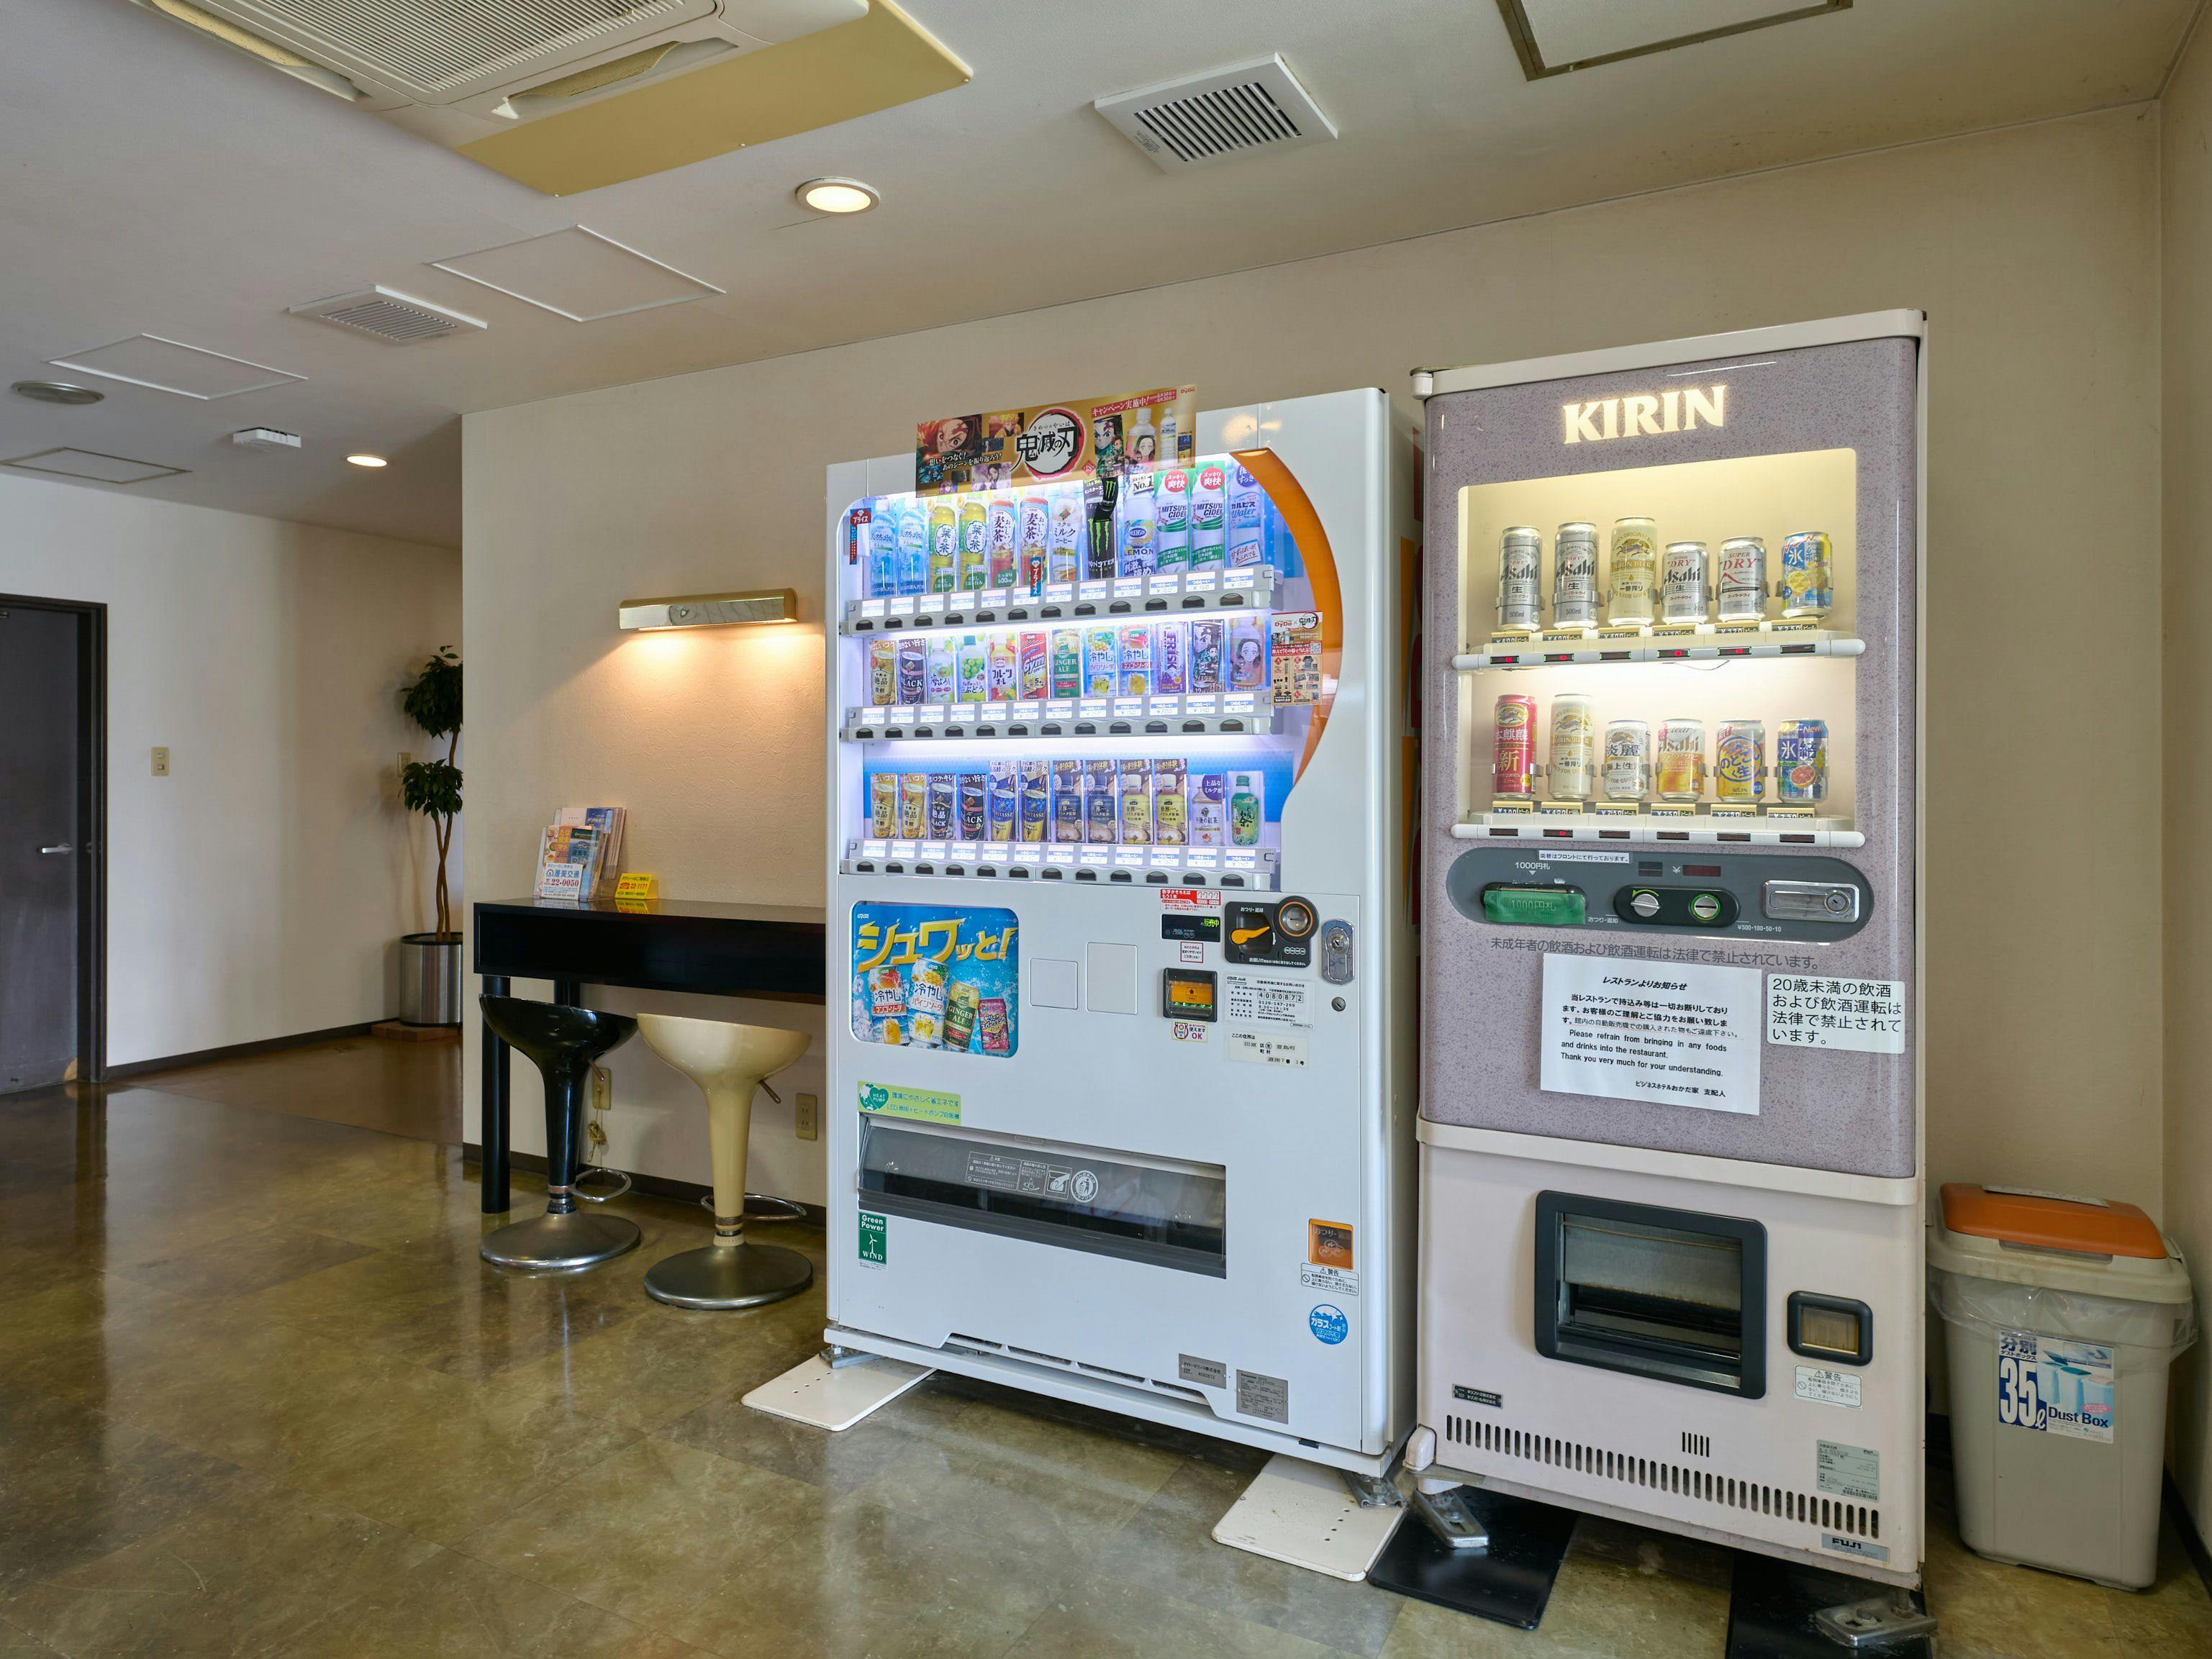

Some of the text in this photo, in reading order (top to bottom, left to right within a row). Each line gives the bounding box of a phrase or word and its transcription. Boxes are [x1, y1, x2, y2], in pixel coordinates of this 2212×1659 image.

[1563, 386, 1727, 445] KIRIN
[1010, 426, 1080, 472] 鬼滅の刃
[1167, 481, 1186, 489] 爽快
[1203, 478, 1222, 486] 爽快
[853, 515, 869, 524] プライス
[1025, 512, 1038, 540] 麦茶
[992, 515, 1005, 542] 麦茶
[1054, 528, 1076, 537] ミルク
[1788, 547, 1821, 565] 氷結
[1500, 563, 1538, 581] Asahi
[1556, 560, 1595, 578] Asahi
[1664, 567, 1700, 583] Asahi
[1089, 652, 1113, 663] 冷やし
[1124, 650, 1149, 660] 冷やし
[1166, 633, 1178, 670] FRISK
[992, 669, 1012, 679] フルーツ
[1495, 728, 1528, 741] 本麒麟
[1803, 725, 1822, 734] New
[1605, 744, 1641, 757] 淡麗
[1658, 735, 1699, 753] Asahi
[1498, 750, 1520, 773] 新
[1721, 752, 1760, 768] のどごし
[1540, 852, 1628, 863] 両替はフロントにて行っております。
[1515, 861, 1550, 871] 1000円札
[1672, 865, 1681, 874] ¥
[1511, 899, 1556, 912] 1000円札
[856, 919, 1018, 973] シュワッと!
[1491, 937, 1818, 970] 未成年者の飲酒および飲酒運転は法律で禁止されています。
[1603, 976, 1687, 991] レストランよりお知らせ
[1772, 978, 1891, 998] 20歳未満の飲酒
[874, 988, 901, 1003] 冷やし
[915, 983, 943, 1001] 冷やし
[1571, 993, 1728, 1014] 当レストランで持込み等は一切お断りしており
[1772, 994, 1901, 1015] および飲酒運転は
[949, 1005, 973, 1019] GINGER
[951, 1014, 966, 1024] ALE
[1562, 1005, 1727, 1027] ます。お客様のご理解とご協力をお願い致しま
[1772, 1011, 1901, 1032] 法律で禁止されて
[1569, 1029, 1593, 1038] Please
[1624, 1034, 1640, 1042] from
[1644, 1036, 1673, 1047] bringing
[1677, 1039, 1684, 1047] in
[1688, 1041, 1701, 1050] any
[1705, 1042, 1727, 1052] foods
[1772, 1029, 1826, 1045] います。
[1576, 1042, 1597, 1051] drinks
[1600, 1044, 1613, 1053] into
[1629, 1047, 1668, 1058] restaurant.
[1561, 1052, 1723, 1077] Thank you very much for your understanding.
[1636, 1081, 1726, 1098] ビジネスホテルおかだ家 支配人
[892, 1091, 959, 1107] 環境にやさしく省エネです
[861, 1214, 884, 1225] Green
[861, 1222, 884, 1232] Power
[863, 1250, 883, 1260] WIND
[2000, 1337, 2037, 1355] 分別
[2000, 1350, 2036, 1361] ダストボックス
[1825, 1371, 1842, 1381] 警告
[2048, 1406, 2108, 1428] Dust Box
[1831, 1537, 1862, 1550] FUJI
